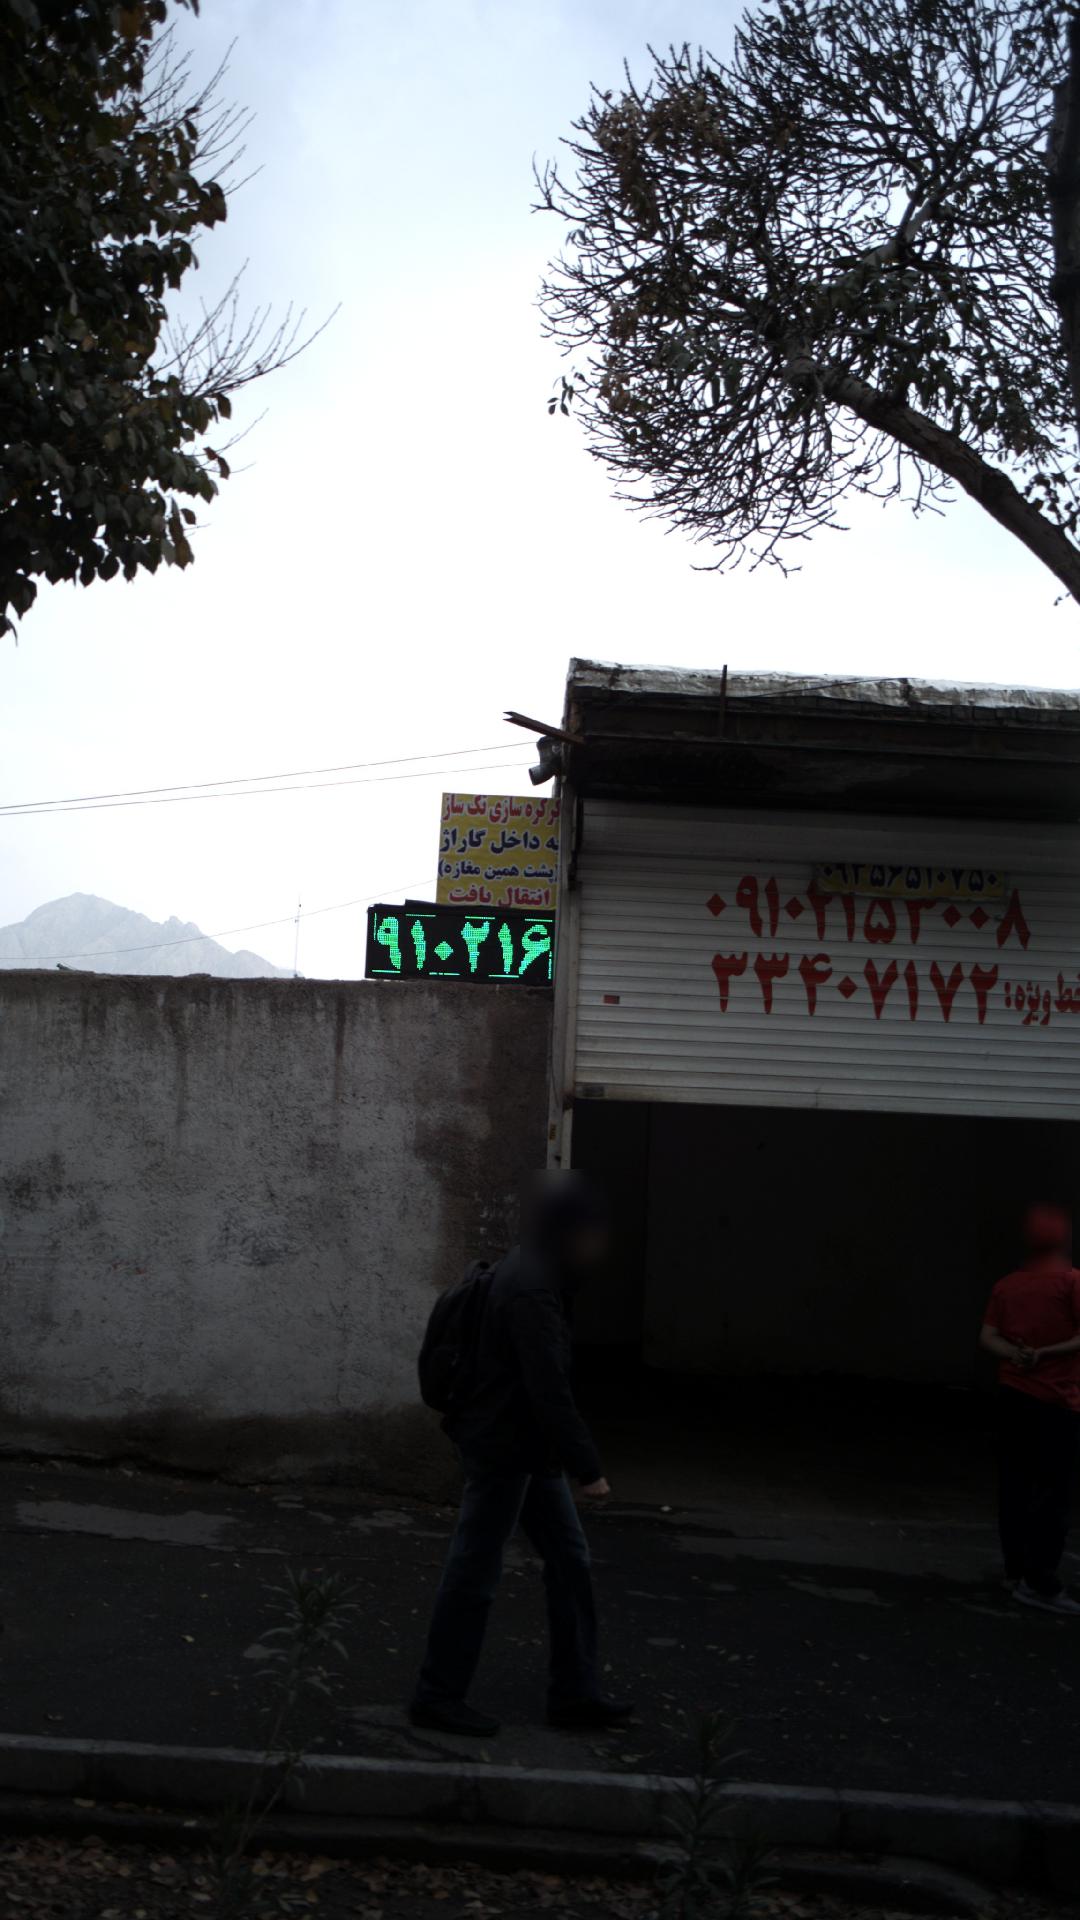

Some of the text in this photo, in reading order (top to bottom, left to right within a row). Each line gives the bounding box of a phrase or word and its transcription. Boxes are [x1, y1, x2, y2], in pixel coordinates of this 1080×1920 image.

[443, 793, 464, 820] ساز
[467, 795, 487, 815] تک
[490, 797, 522, 823] سازی
[440, 828, 486, 853] گاراژ
[491, 830, 540, 854] داخل
[484, 866, 519, 880] همین
[449, 884, 550, 908] انتقال یافت
[712, 952, 998, 1025] ۳۳۴۰۷۱۷۲
[1004, 981, 1051, 1026] ویژه:
